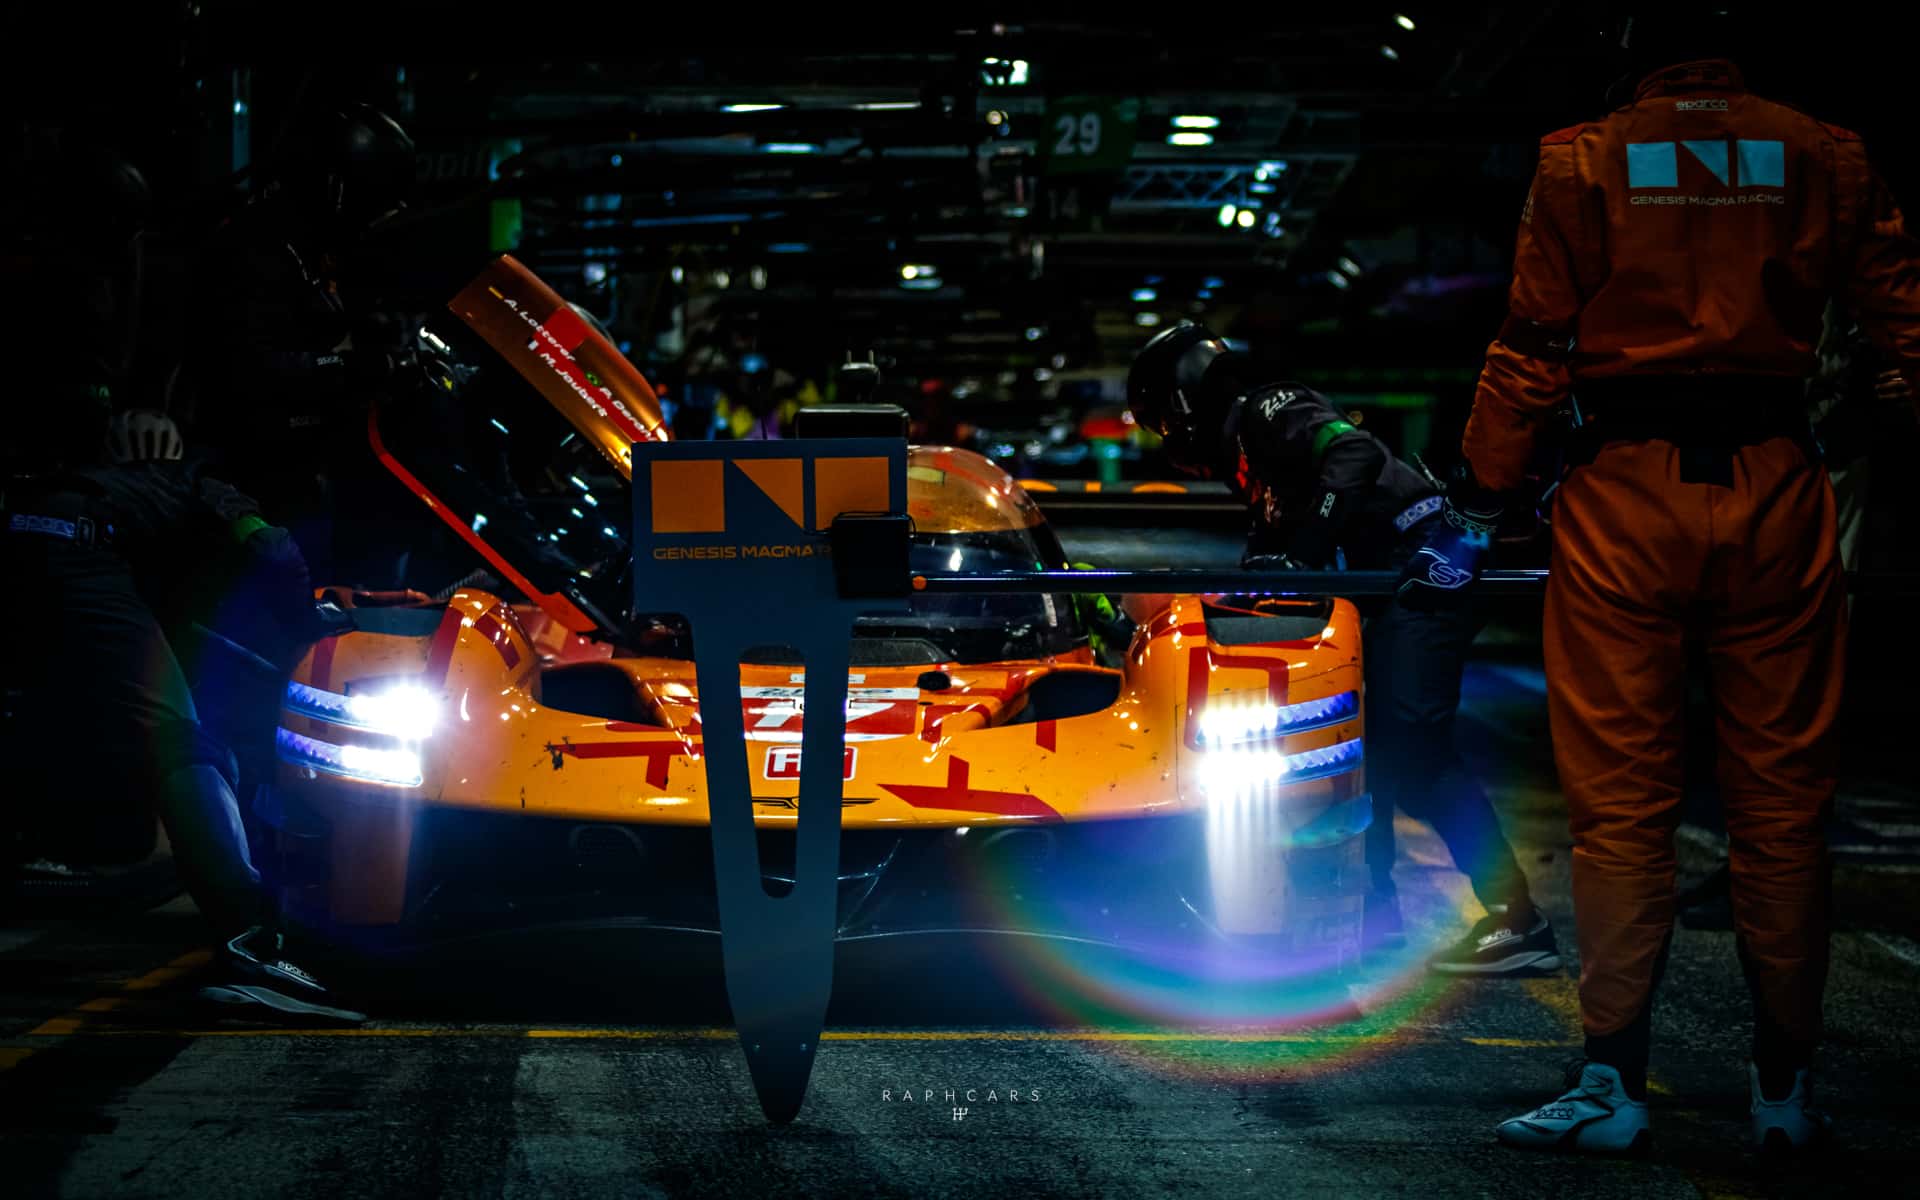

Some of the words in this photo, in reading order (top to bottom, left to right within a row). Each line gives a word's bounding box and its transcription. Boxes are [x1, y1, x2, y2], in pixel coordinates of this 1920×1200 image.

[1055, 112, 1102, 158] 29
[1629, 195, 1686, 206] GENESIS
[1688, 195, 1736, 207] MAGMA
[1737, 193, 1785, 206] RACING
[653, 546, 737, 560] GENESIS
[741, 544, 814, 558] MAGMA
